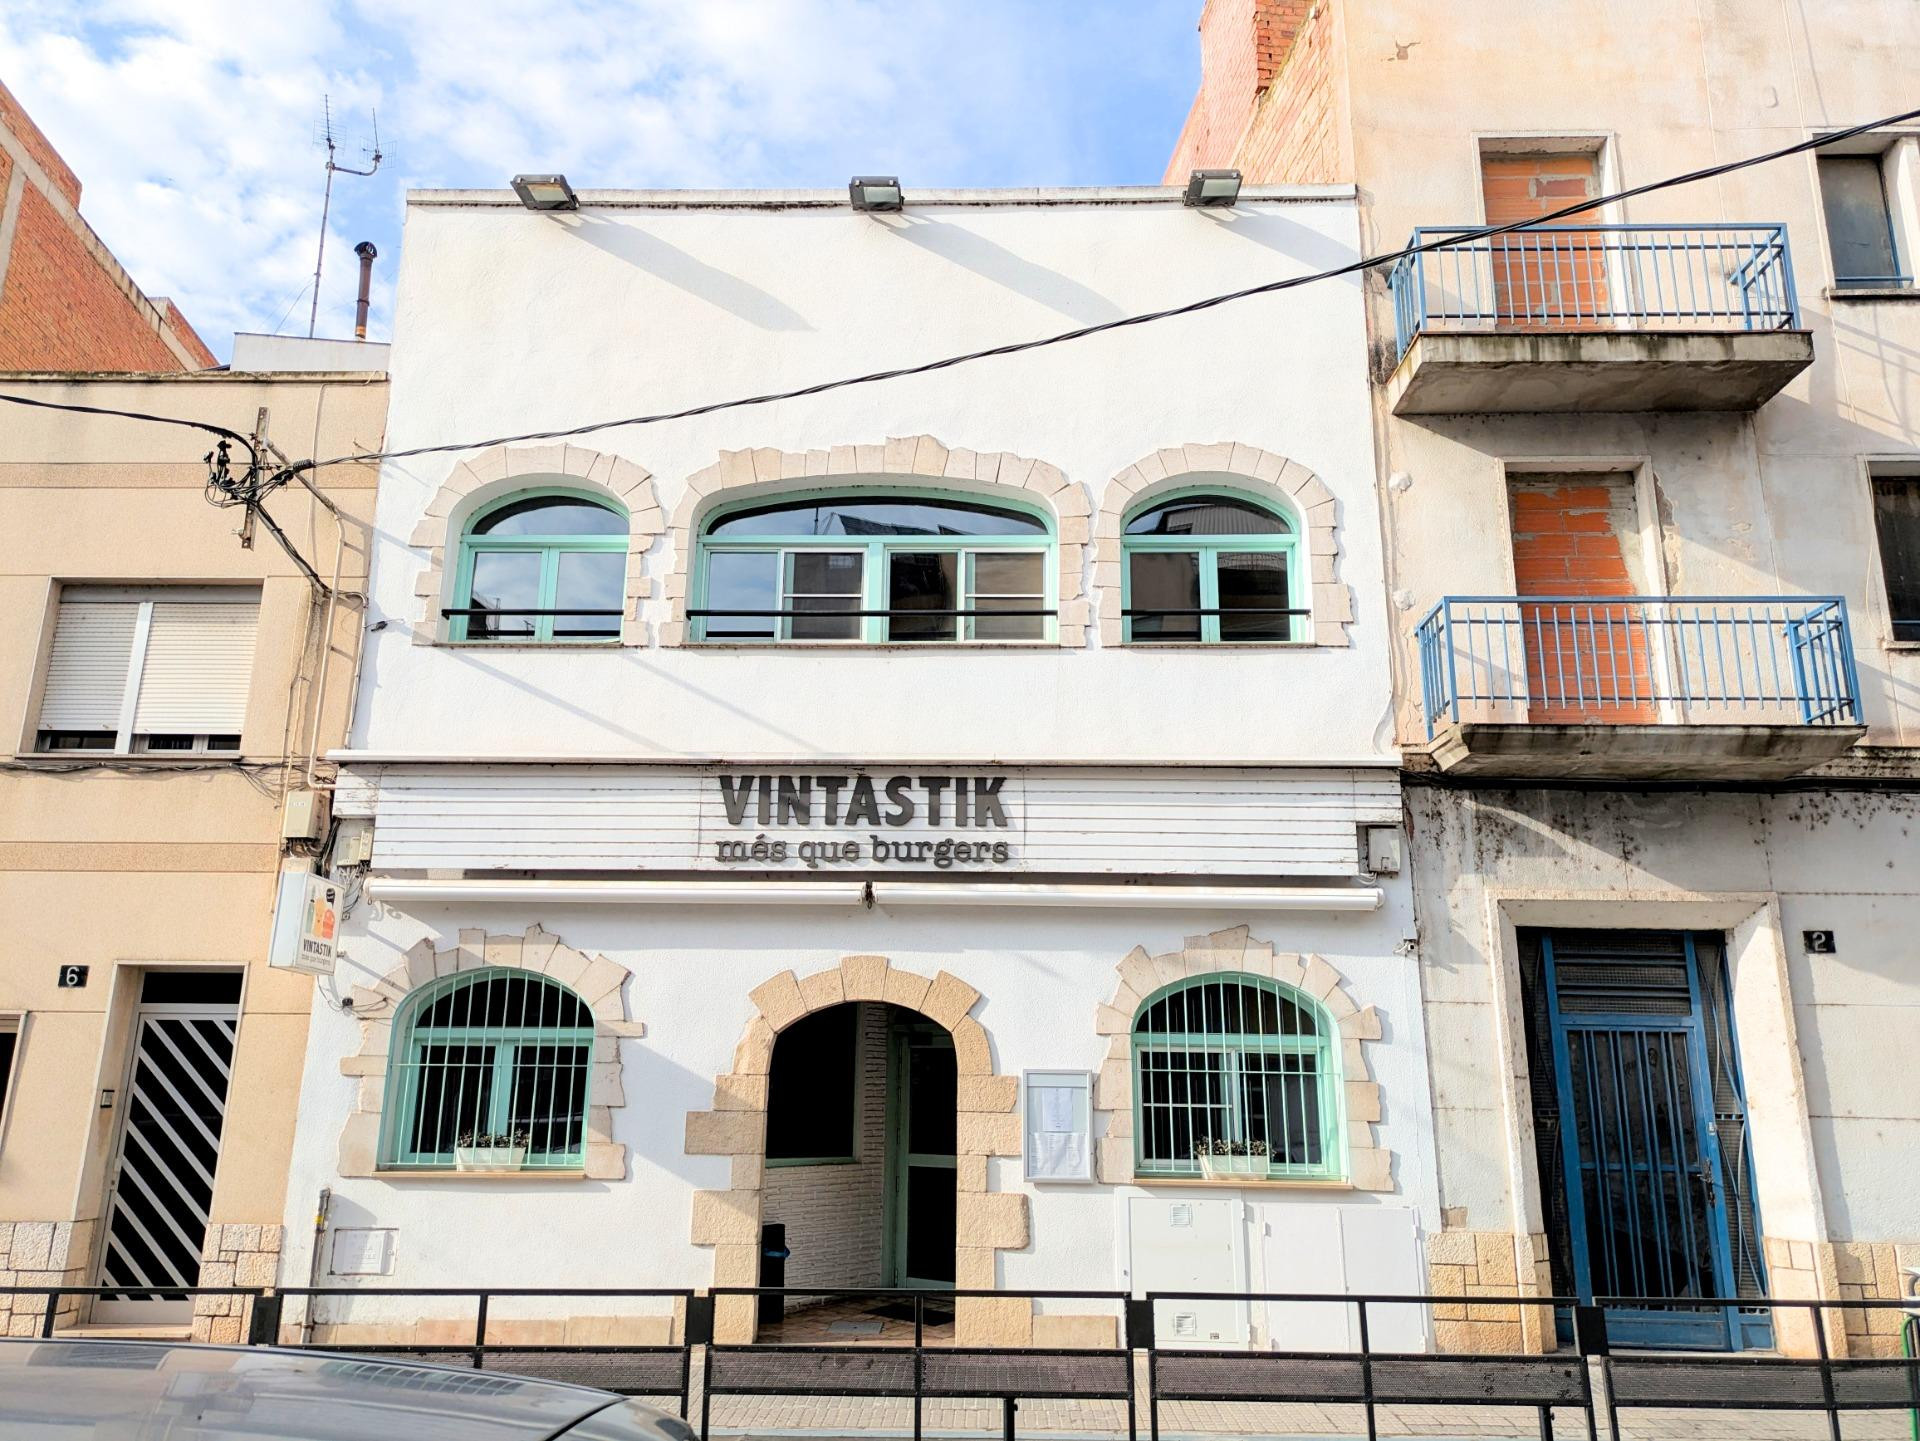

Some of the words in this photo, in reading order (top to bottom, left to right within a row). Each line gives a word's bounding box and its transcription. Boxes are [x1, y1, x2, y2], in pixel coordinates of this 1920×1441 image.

[718, 775, 1008, 827] VINTASTIK
[715, 833, 787, 862] més
[798, 840, 860, 868] que
[869, 835, 1009, 869] burgers
[304, 938, 332, 958] VINTASTIK
[1813, 932, 1827, 951] 2
[66, 966, 79, 985] 6
